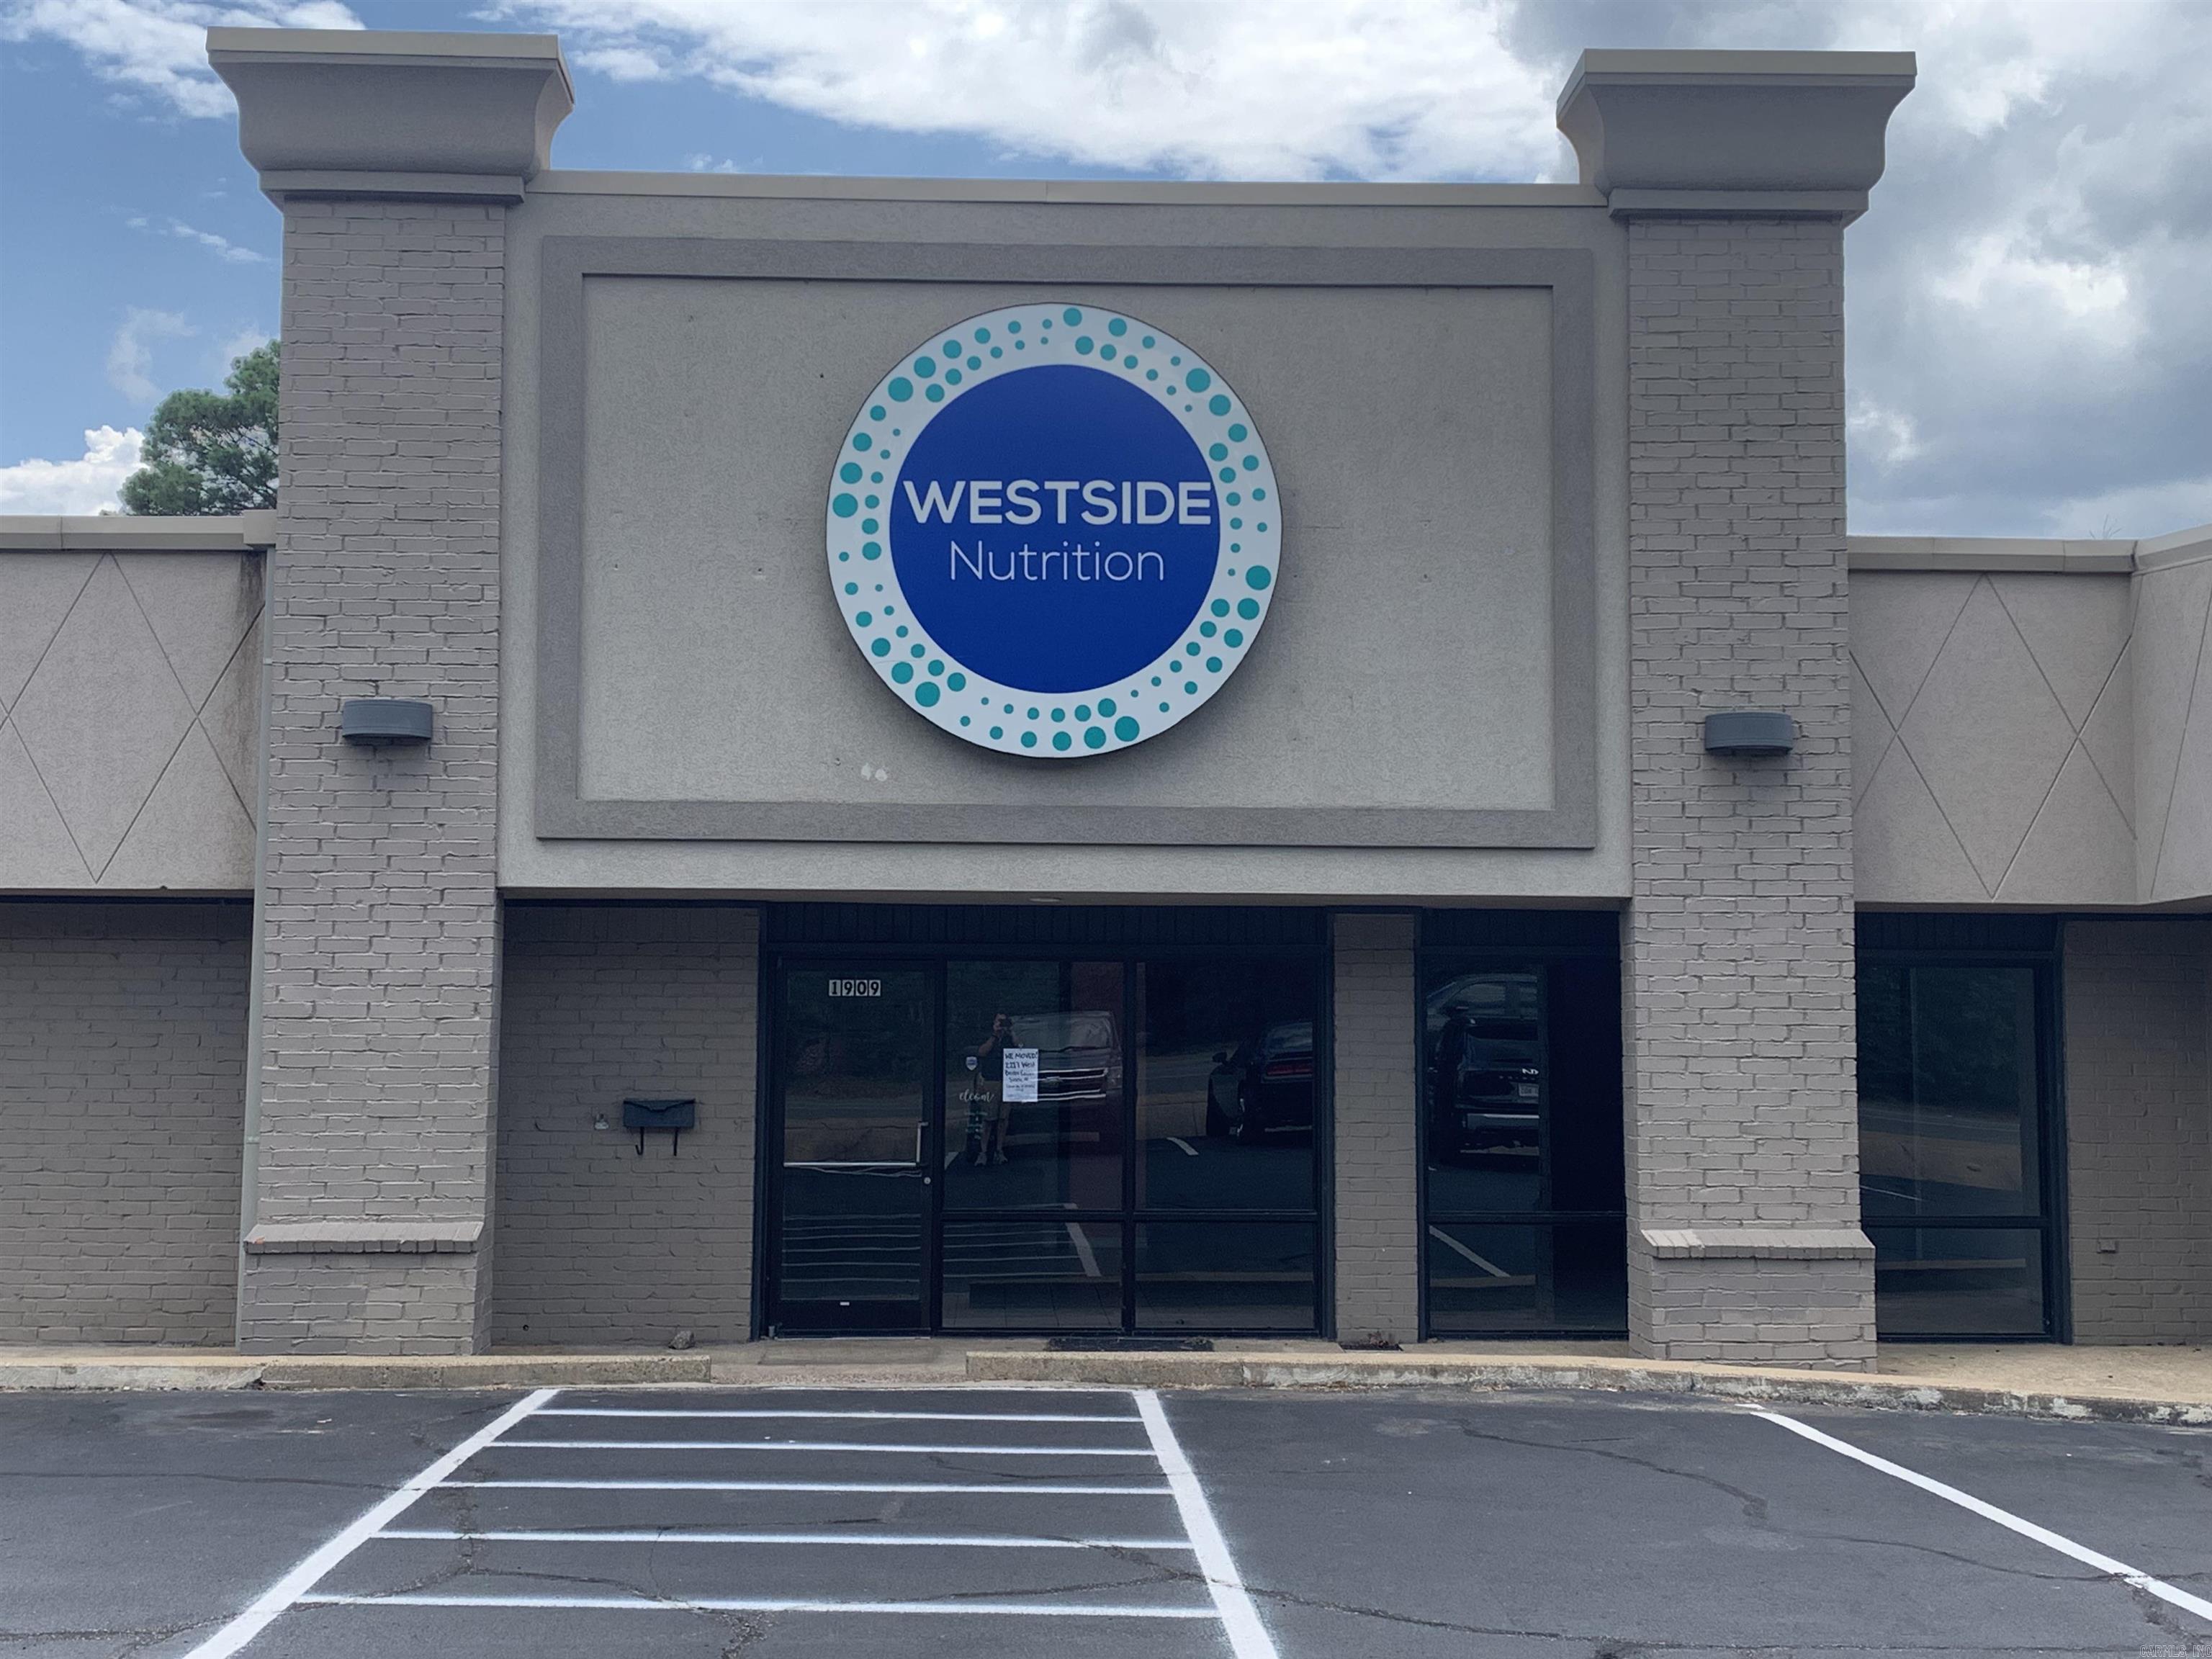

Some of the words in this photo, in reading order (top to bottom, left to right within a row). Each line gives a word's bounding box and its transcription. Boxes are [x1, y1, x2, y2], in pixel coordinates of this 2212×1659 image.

[903, 480, 1211, 525] WESTSIDE
[950, 540, 1164, 581] Nutrition
[831, 981, 880, 995] 1909
